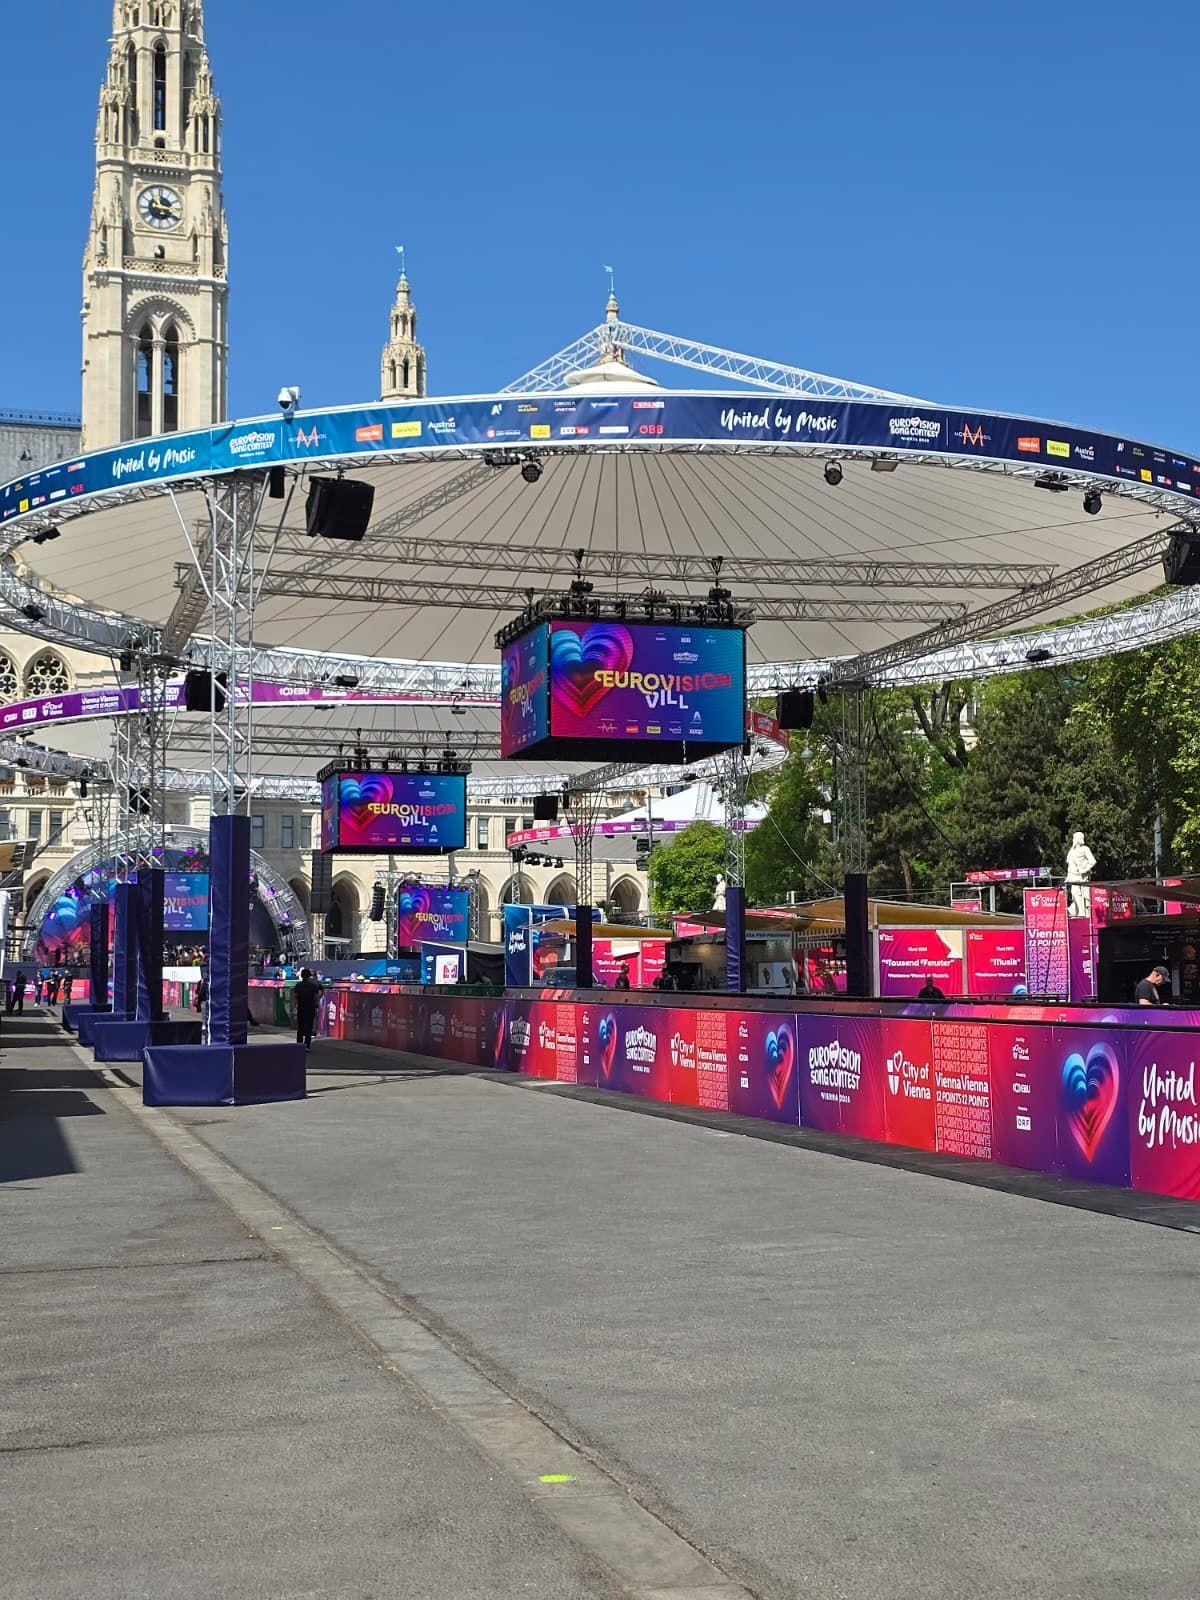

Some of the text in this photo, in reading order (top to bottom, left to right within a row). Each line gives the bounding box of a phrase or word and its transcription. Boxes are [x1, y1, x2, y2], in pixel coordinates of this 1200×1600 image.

[428, 421, 456, 429] Austria
[721, 407, 837, 433] United by Music
[1074, 446, 1094, 456] Austria
[112, 451, 144, 479] United
[148, 448, 161, 472] by
[163, 447, 196, 469] Music
[594, 669, 732, 695] EUROVISION
[368, 802, 456, 818] EUROVISION
[1028, 929, 1065, 938] Vienna
[1038, 939, 1065, 947] POINTS
[680, 1039, 695, 1057] City of
[680, 1054, 696, 1069] Vienna
[829, 1068, 861, 1090] CONTEST
[902, 1061, 929, 1084] City of
[903, 1080, 931, 1100] Vienna
[935, 1072, 989, 1093] Vienna Vienna
[1143, 1061, 1197, 1107] United
[936, 1091, 989, 1107] 12 POINTS 12 POINTS
[1017, 1118, 1030, 1127] ORF
[1138, 1098, 1200, 1150] by Musi
